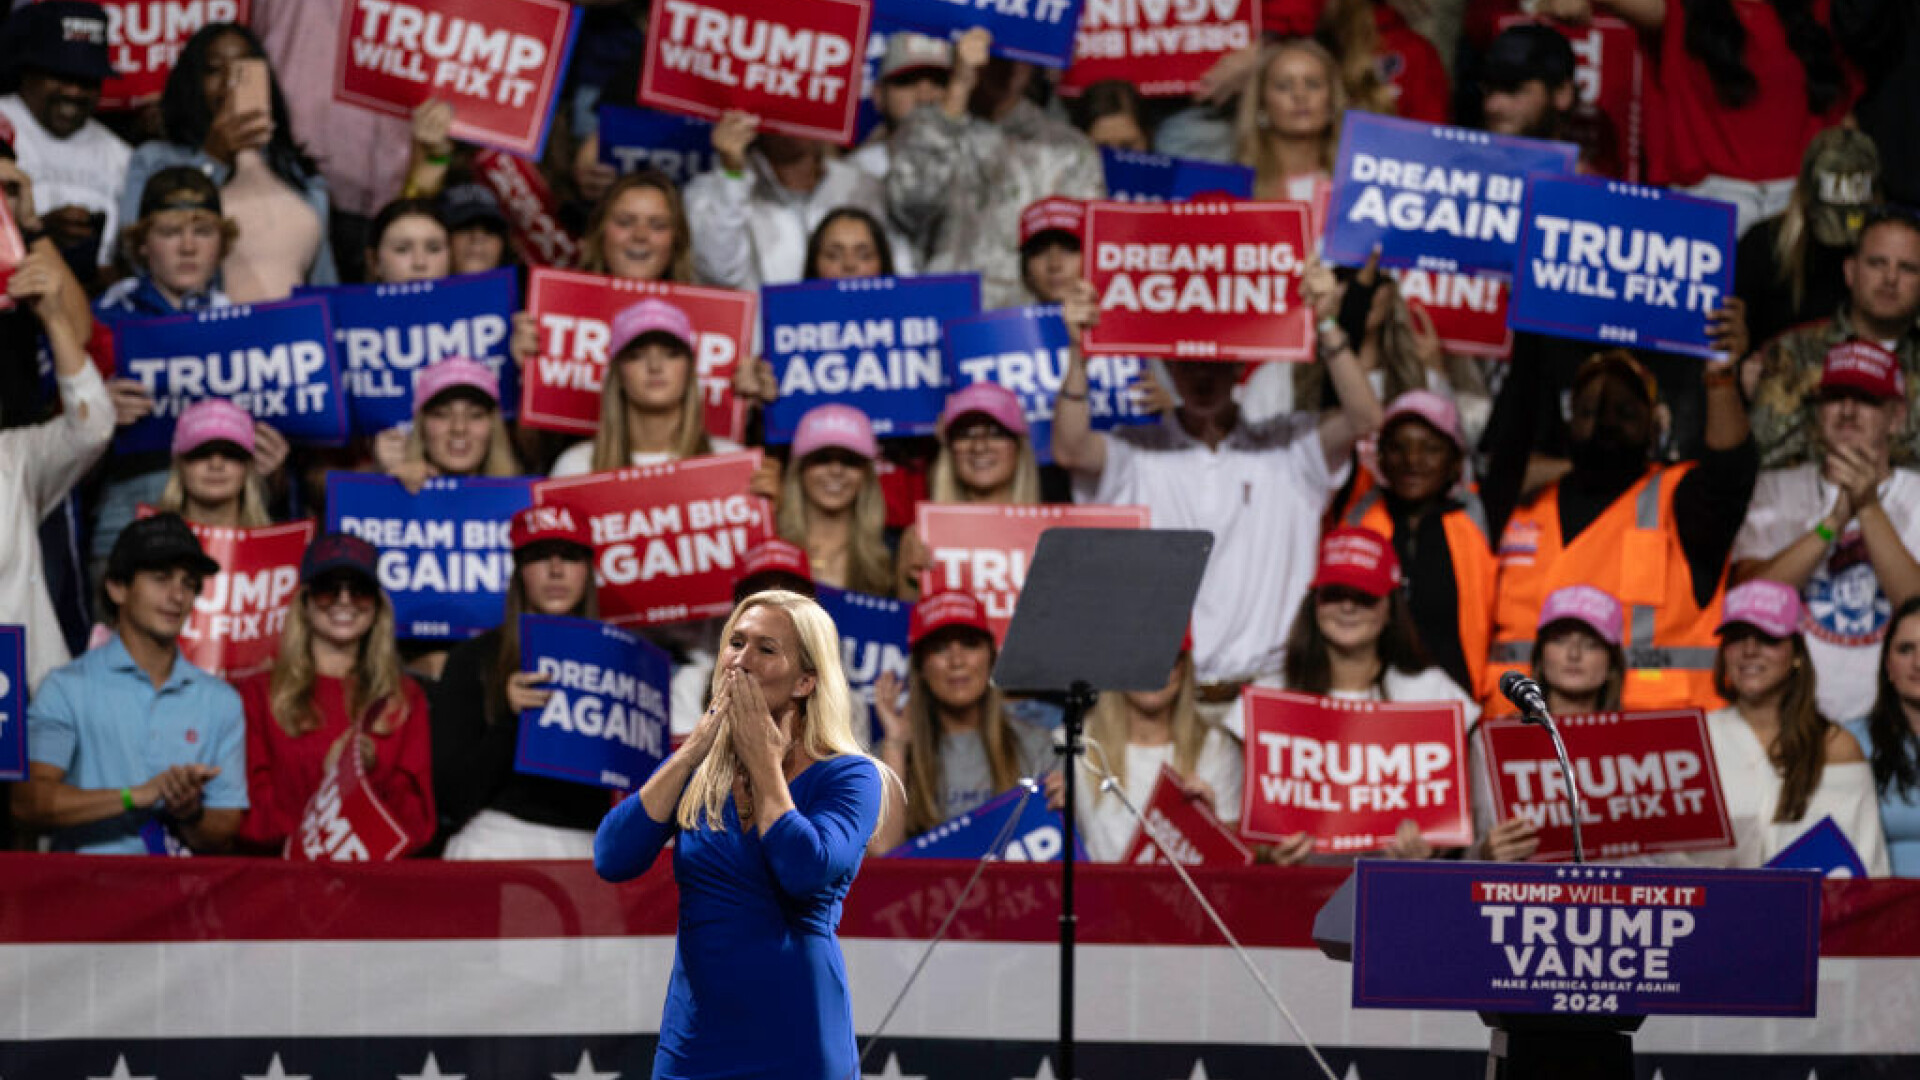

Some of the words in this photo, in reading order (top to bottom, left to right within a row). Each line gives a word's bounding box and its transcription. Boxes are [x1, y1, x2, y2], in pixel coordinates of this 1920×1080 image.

[103, 0, 238, 45] RUMP
[356, 0, 546, 75] TRUMP
[663, 0, 852, 74] TRUMP
[146, 43, 182, 72] FI
[351, 38, 429, 82] WILL
[433, 60, 494, 99] FIX
[496, 76, 536, 109] IT
[660, 39, 740, 86] WILL
[744, 61, 802, 98] FIX
[807, 75, 845, 104] IT
[1351, 153, 1480, 198] DREAM
[1486, 175, 1524, 203] BI
[1347, 188, 1521, 244] AGAIN
[1097, 243, 1227, 272] DREAM
[1233, 243, 1304, 277] BIG,
[1534, 215, 1722, 282] TRUMP
[1101, 274, 1290, 314] AGAIN!
[1400, 267, 1501, 314] AIN!
[1531, 258, 1618, 301] WILL
[1623, 271, 1680, 311] FIX
[1686, 279, 1720, 315] IT
[335, 313, 508, 369] RUMP
[539, 314, 737, 375] TRP
[774, 319, 895, 354] DREAM
[902, 316, 938, 346] BI
[129, 340, 326, 397] TRUMP
[538, 356, 604, 393] WIL
[780, 348, 945, 396] AGAIN
[297, 382, 329, 414] IT
[340, 515, 455, 549] DREAM
[687, 495, 761, 530] BIG,
[376, 549, 516, 593] GAIN!
[597, 527, 748, 588] GAIN!
[194, 565, 297, 613] UMP
[210, 612, 261, 642] FIX
[538, 655, 637, 703] DREAM
[1258, 730, 1452, 786] TRUMP
[1503, 750, 1701, 802] TRUMP
[1260, 773, 1342, 812] WILL
[1350, 783, 1409, 812] FIX
[1415, 779, 1452, 808] IT
[1511, 800, 1602, 829] WILL
[1607, 792, 1666, 822] FIX
[1673, 788, 1706, 816] IT
[1481, 882, 1562, 901] TRUMP
[1568, 884, 1625, 904] WILL
[1630, 886, 1669, 905] FIX
[1673, 887, 1696, 905] IT
[1480, 905, 1696, 947] TRUMP
[1503, 945, 1671, 979] VANCE
[1491, 979, 1528, 990] MAKE
[1531, 980, 1588, 991] AMERICA
[1592, 980, 1632, 992] GREAT
[1636, 981, 1681, 994] AGAIN!
[1552, 992, 1619, 1013] 2024
